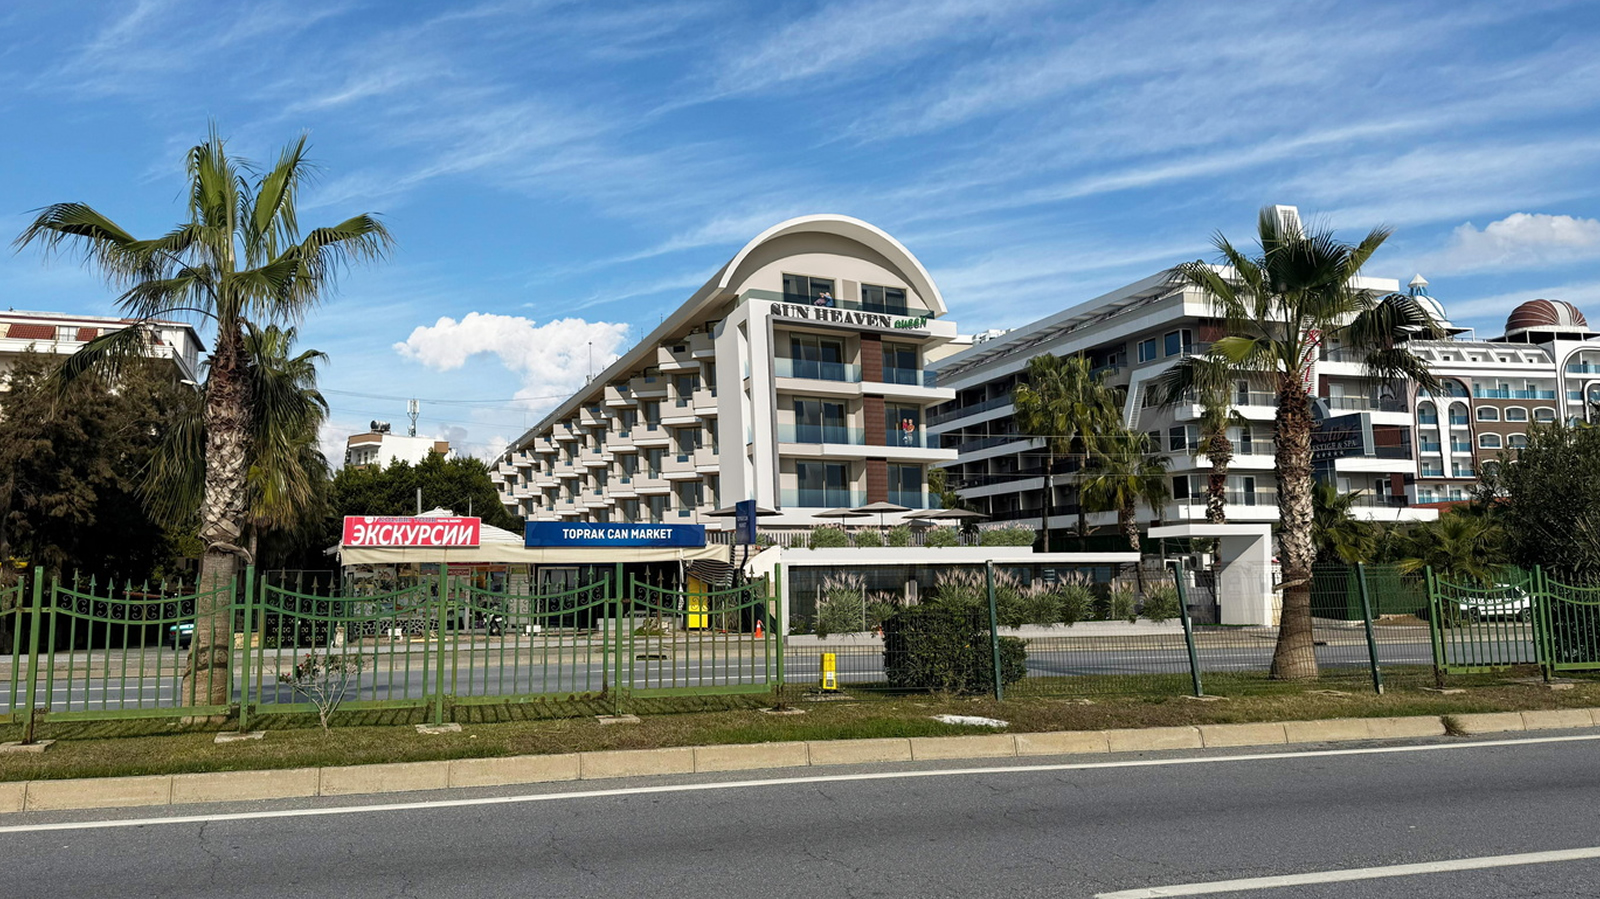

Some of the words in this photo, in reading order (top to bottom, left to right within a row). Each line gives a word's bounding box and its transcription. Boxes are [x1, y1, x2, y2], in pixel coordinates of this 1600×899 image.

[770, 303, 809, 319] SUN
[814, 308, 892, 328] HEAVEN
[351, 525, 474, 546] ЭКСКУРСИИ
[562, 528, 605, 539] TOPRAK
[607, 529, 628, 539] CAN
[631, 529, 673, 539] MARKET
